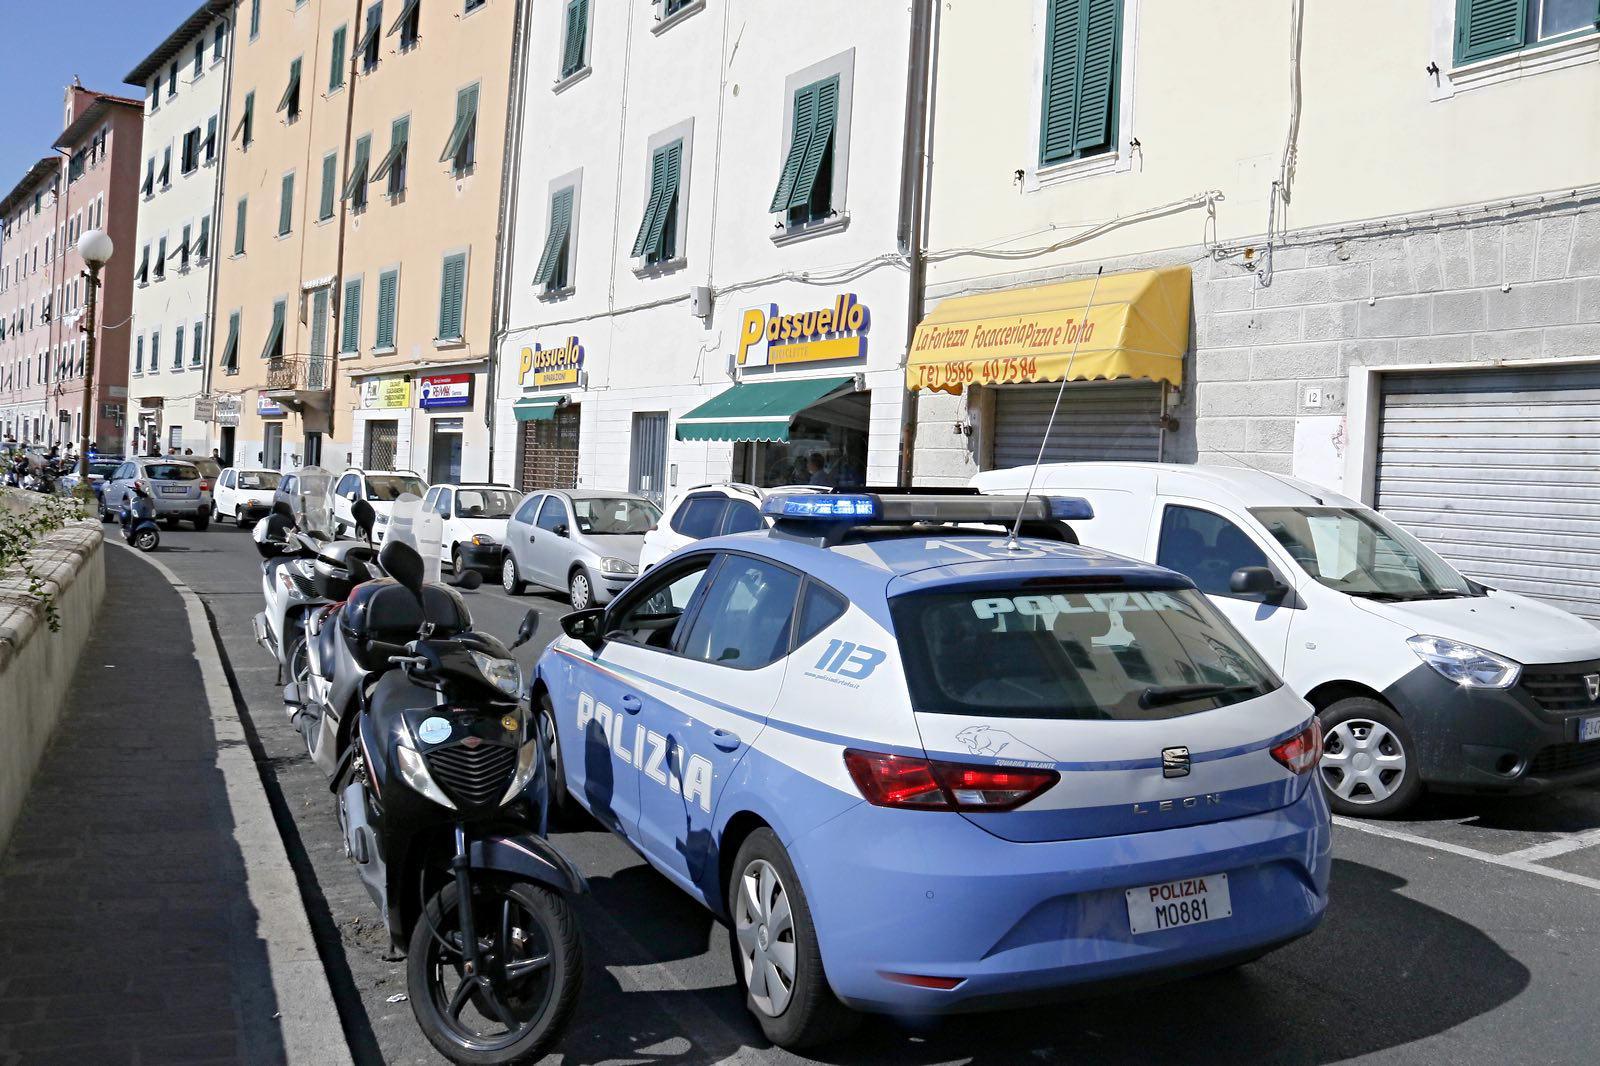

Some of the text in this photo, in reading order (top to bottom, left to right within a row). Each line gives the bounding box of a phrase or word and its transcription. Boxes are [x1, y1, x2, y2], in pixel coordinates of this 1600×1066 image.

[737, 293, 866, 365] Passuello
[916, 318, 1095, 351] La Fortezza Focacceria Pizza e Torta
[518, 336, 581, 385] Passuello
[920, 365, 939, 386] Tel
[945, 361, 973, 383] 0586
[1308, 392, 1318, 403] 12
[971, 592, 1184, 620] POLIZIA
[814, 638, 887, 680] 113
[577, 691, 713, 813] POLIZIA
[995, 759, 1056, 769] SQUADRA VOLANTE
[1133, 793, 1220, 815] LEON
[1149, 879, 1207, 902] POLIZIA
[1155, 898, 1208, 928] M0881
